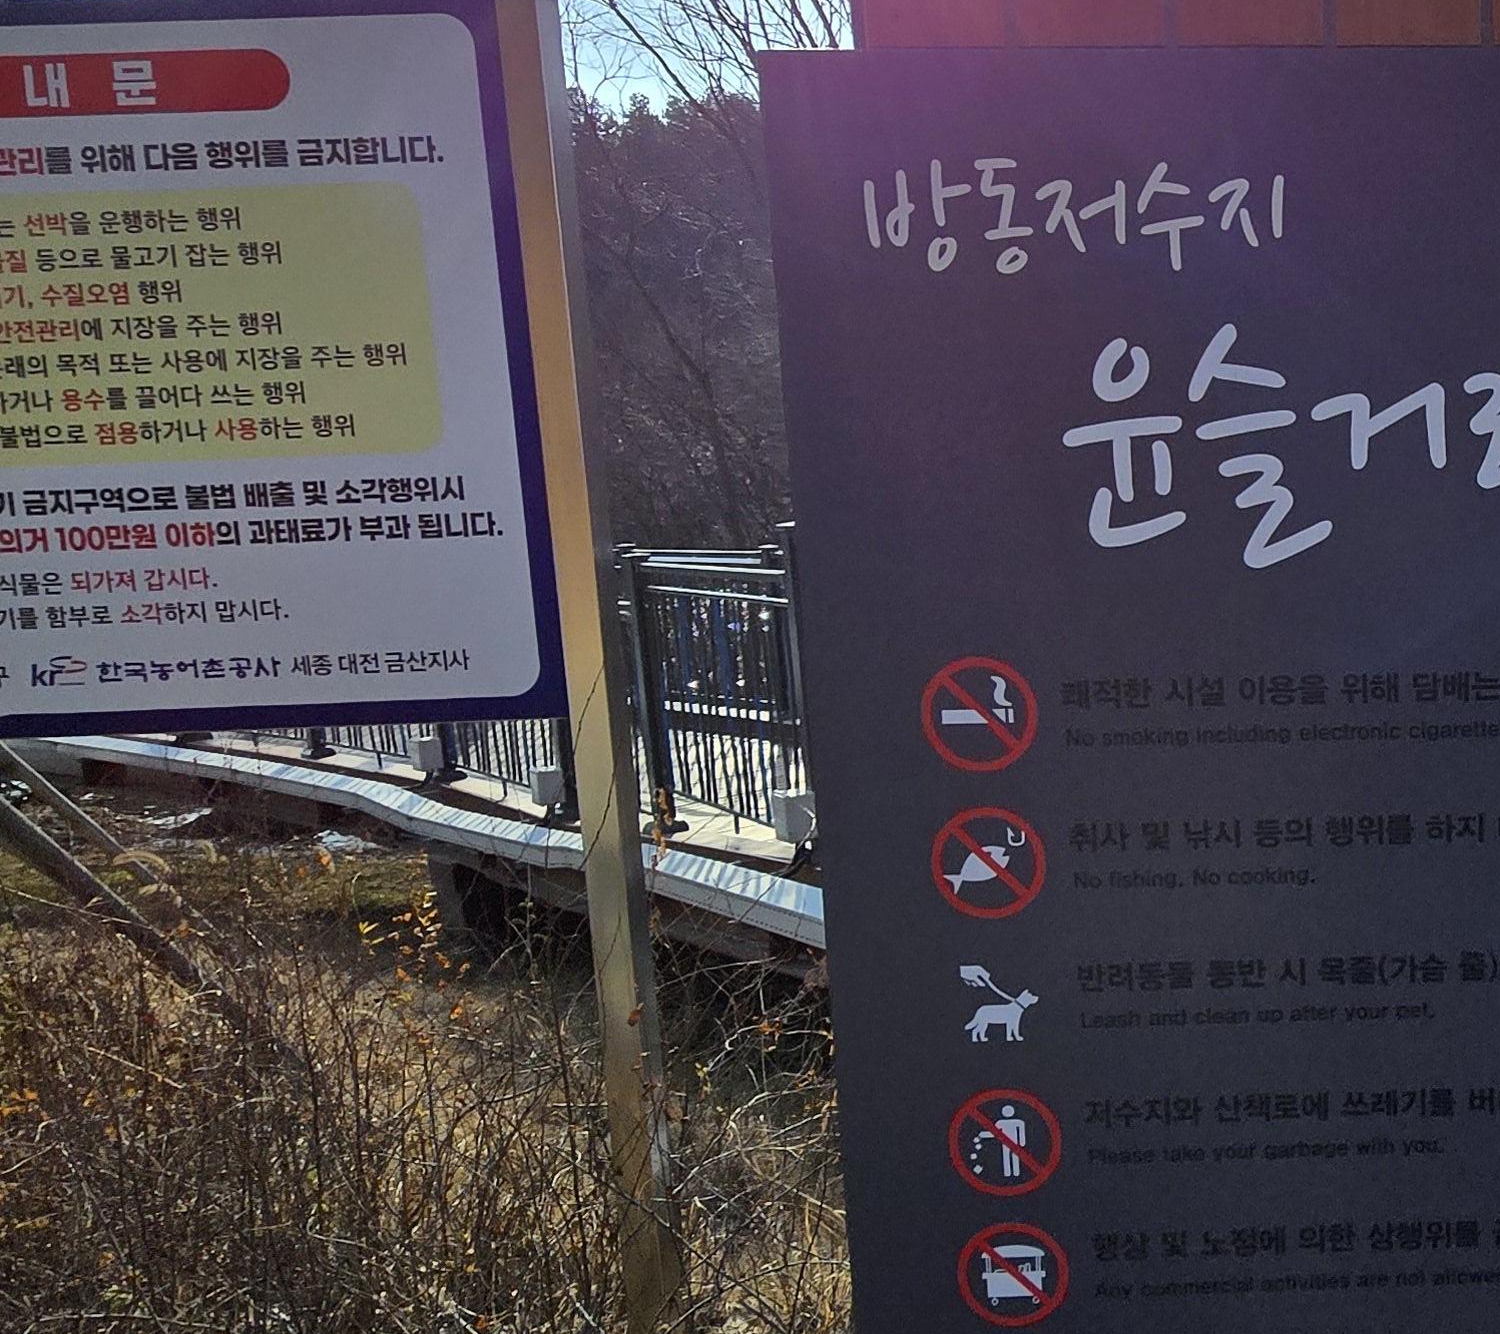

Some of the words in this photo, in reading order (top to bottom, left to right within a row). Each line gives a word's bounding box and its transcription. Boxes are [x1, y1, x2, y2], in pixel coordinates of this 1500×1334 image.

[23, 63, 70, 108] 내
[112, 60, 157, 106] 문
[80, 144, 136, 173] 위해
[143, 142, 198, 171] 다음
[204, 139, 289, 169] 행위를
[297, 135, 444, 167] 금지합니다.
[24, 211, 91, 236] 선박을
[98, 208, 189, 234] 운행하는
[195, 206, 241, 232] 행위
[863, 158, 1285, 273] 방동저수지
[0, 248, 28, 274] 질
[35, 247, 103, 272] 등으로
[110, 244, 178, 270] 물고기
[185, 242, 230, 267] 잡는
[237, 240, 282, 266] 행위
[0, 284, 34, 309] 기,
[40, 281, 130, 307] 수질오염
[138, 279, 182, 304] 행위
[111, 314, 178, 340] 지장을
[186, 313, 231, 337] 주는
[238, 310, 282, 336] 행위
[0, 353, 48, 379] 래의
[56, 352, 100, 376] 목적
[109, 351, 152, 375] 또는
[161, 348, 228, 373] 사용에
[236, 346, 302, 370] 지장을
[310, 345, 355, 368] 주는
[362, 342, 407, 367] 행위
[61, 387, 127, 412] 용수를
[135, 384, 203, 409] 끌어다
[210, 383, 254, 406] 쓰는
[262, 380, 306, 405] 행위
[0, 424, 88, 448] 불법으로
[94, 418, 207, 445] 점용하거나
[214, 416, 304, 441] 사용하는
[310, 413, 356, 438] 행위
[22, 485, 178, 516] 금지구역으로
[185, 483, 236, 510] 불법
[244, 481, 295, 508] 배출
[302, 479, 328, 506] 및
[335, 475, 465, 504] 소각행위시
[0, 527, 50, 554] 의거
[54, 523, 157, 551] 100만원
[165, 520, 241, 547] 이하의
[248, 517, 352, 544] 과태료가
[359, 514, 411, 541] 부과
[417, 512, 504, 539] 됩니다.
[70, 569, 137, 594] 되가져
[143, 567, 218, 592] 갑시다.
[45, 605, 113, 628] 함부로
[120, 600, 208, 625] 소각하지
[215, 598, 289, 622] 맙시다.
[96, 656, 281, 684] 한국농어촌공사
[291, 654, 332, 677] 세종
[338, 653, 380, 675] 대전
[384, 649, 470, 673] 금산지사
[1165, 675, 1225, 706] 시설
[1239, 673, 1329, 705] 이용을
[1340, 672, 1399, 703] 위해
[1065, 728, 1095, 747] No
[1102, 727, 1189, 748] smoking
[1197, 724, 1291, 744] including
[1299, 722, 1401, 741] electronic
[1069, 822, 1129, 853] 취사
[1141, 822, 1170, 851] 및
[1183, 819, 1241, 850] 낚시
[1253, 818, 1312, 848] 등의
[1325, 814, 1414, 847] 행위를
[1425, 813, 1485, 842] 하지
[1073, 871, 1101, 889] No
[1109, 869, 1184, 889] fishing.
[1193, 868, 1220, 886] No
[1227, 868, 1316, 888] cooking.
[1077, 961, 1194, 992] 반려동물
[1207, 958, 1266, 989] 동반
[1279, 957, 1307, 986] 시
[1084, 1096, 1202, 1127] 저수지와
[1214, 1091, 1330, 1123] 산책로에
[1341, 1088, 1455, 1118] 쓰레기를
[1092, 1230, 1150, 1261] 행상
[1161, 1229, 1188, 1258] 및
[1200, 1226, 1286, 1257] 노점에
[1300, 1223, 1355, 1253] 의한
[1368, 1220, 1480, 1251] 상행위를
